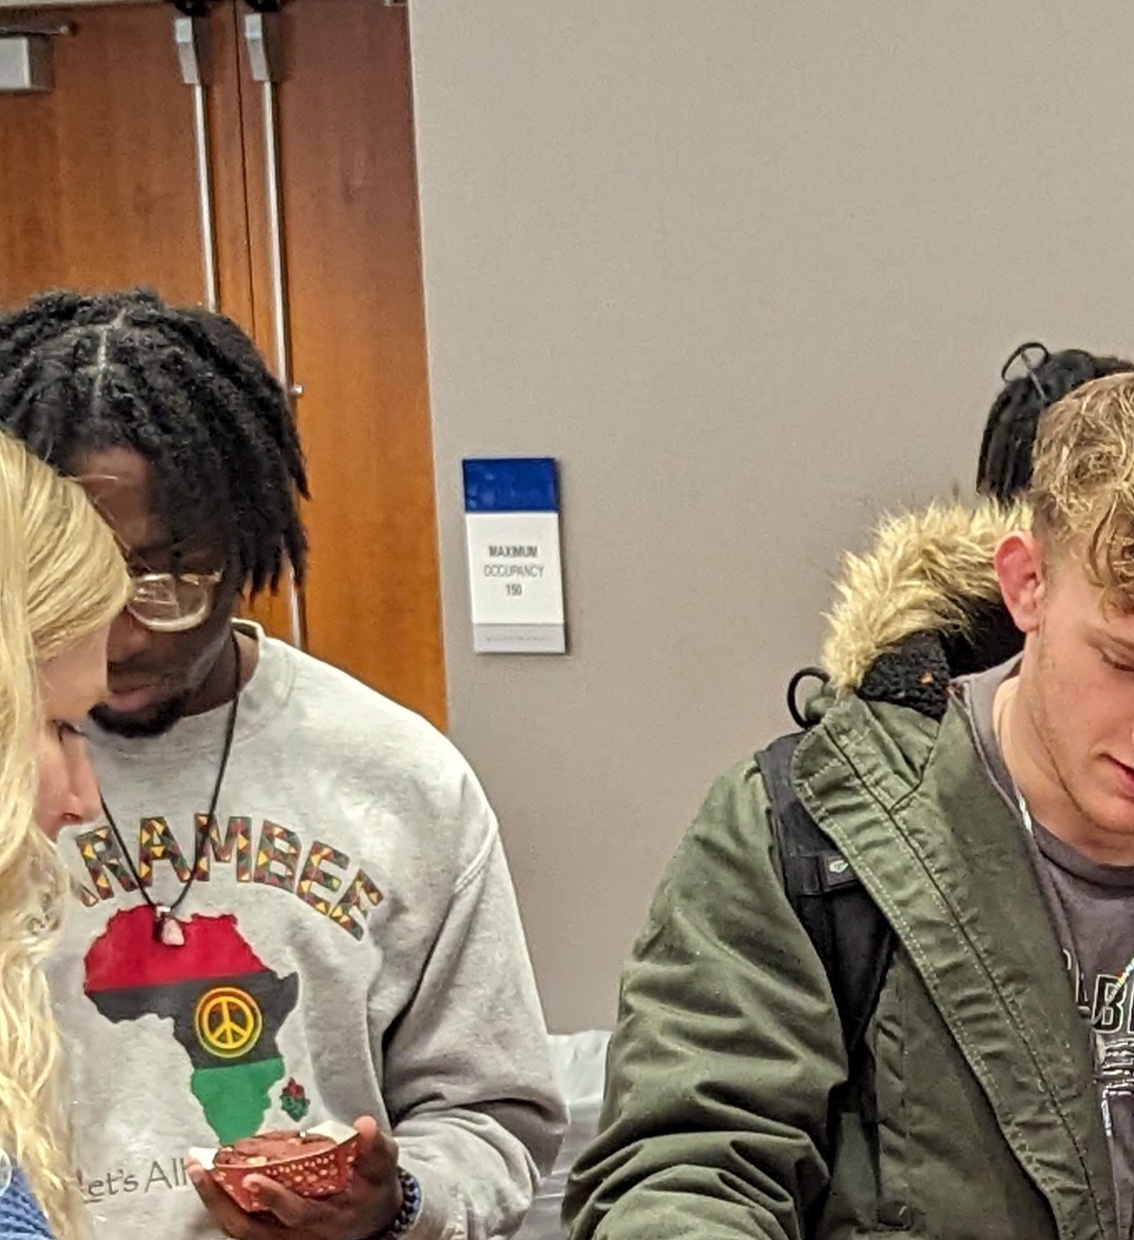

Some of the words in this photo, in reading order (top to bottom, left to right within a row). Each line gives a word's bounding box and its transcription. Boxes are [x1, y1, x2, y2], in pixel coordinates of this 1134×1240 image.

[489, 545, 538, 558] MAXIMUM
[485, 564, 544, 578] OCCUPANCY
[506, 583, 522, 596] 150
[72, 814, 384, 942] RAMBEE
